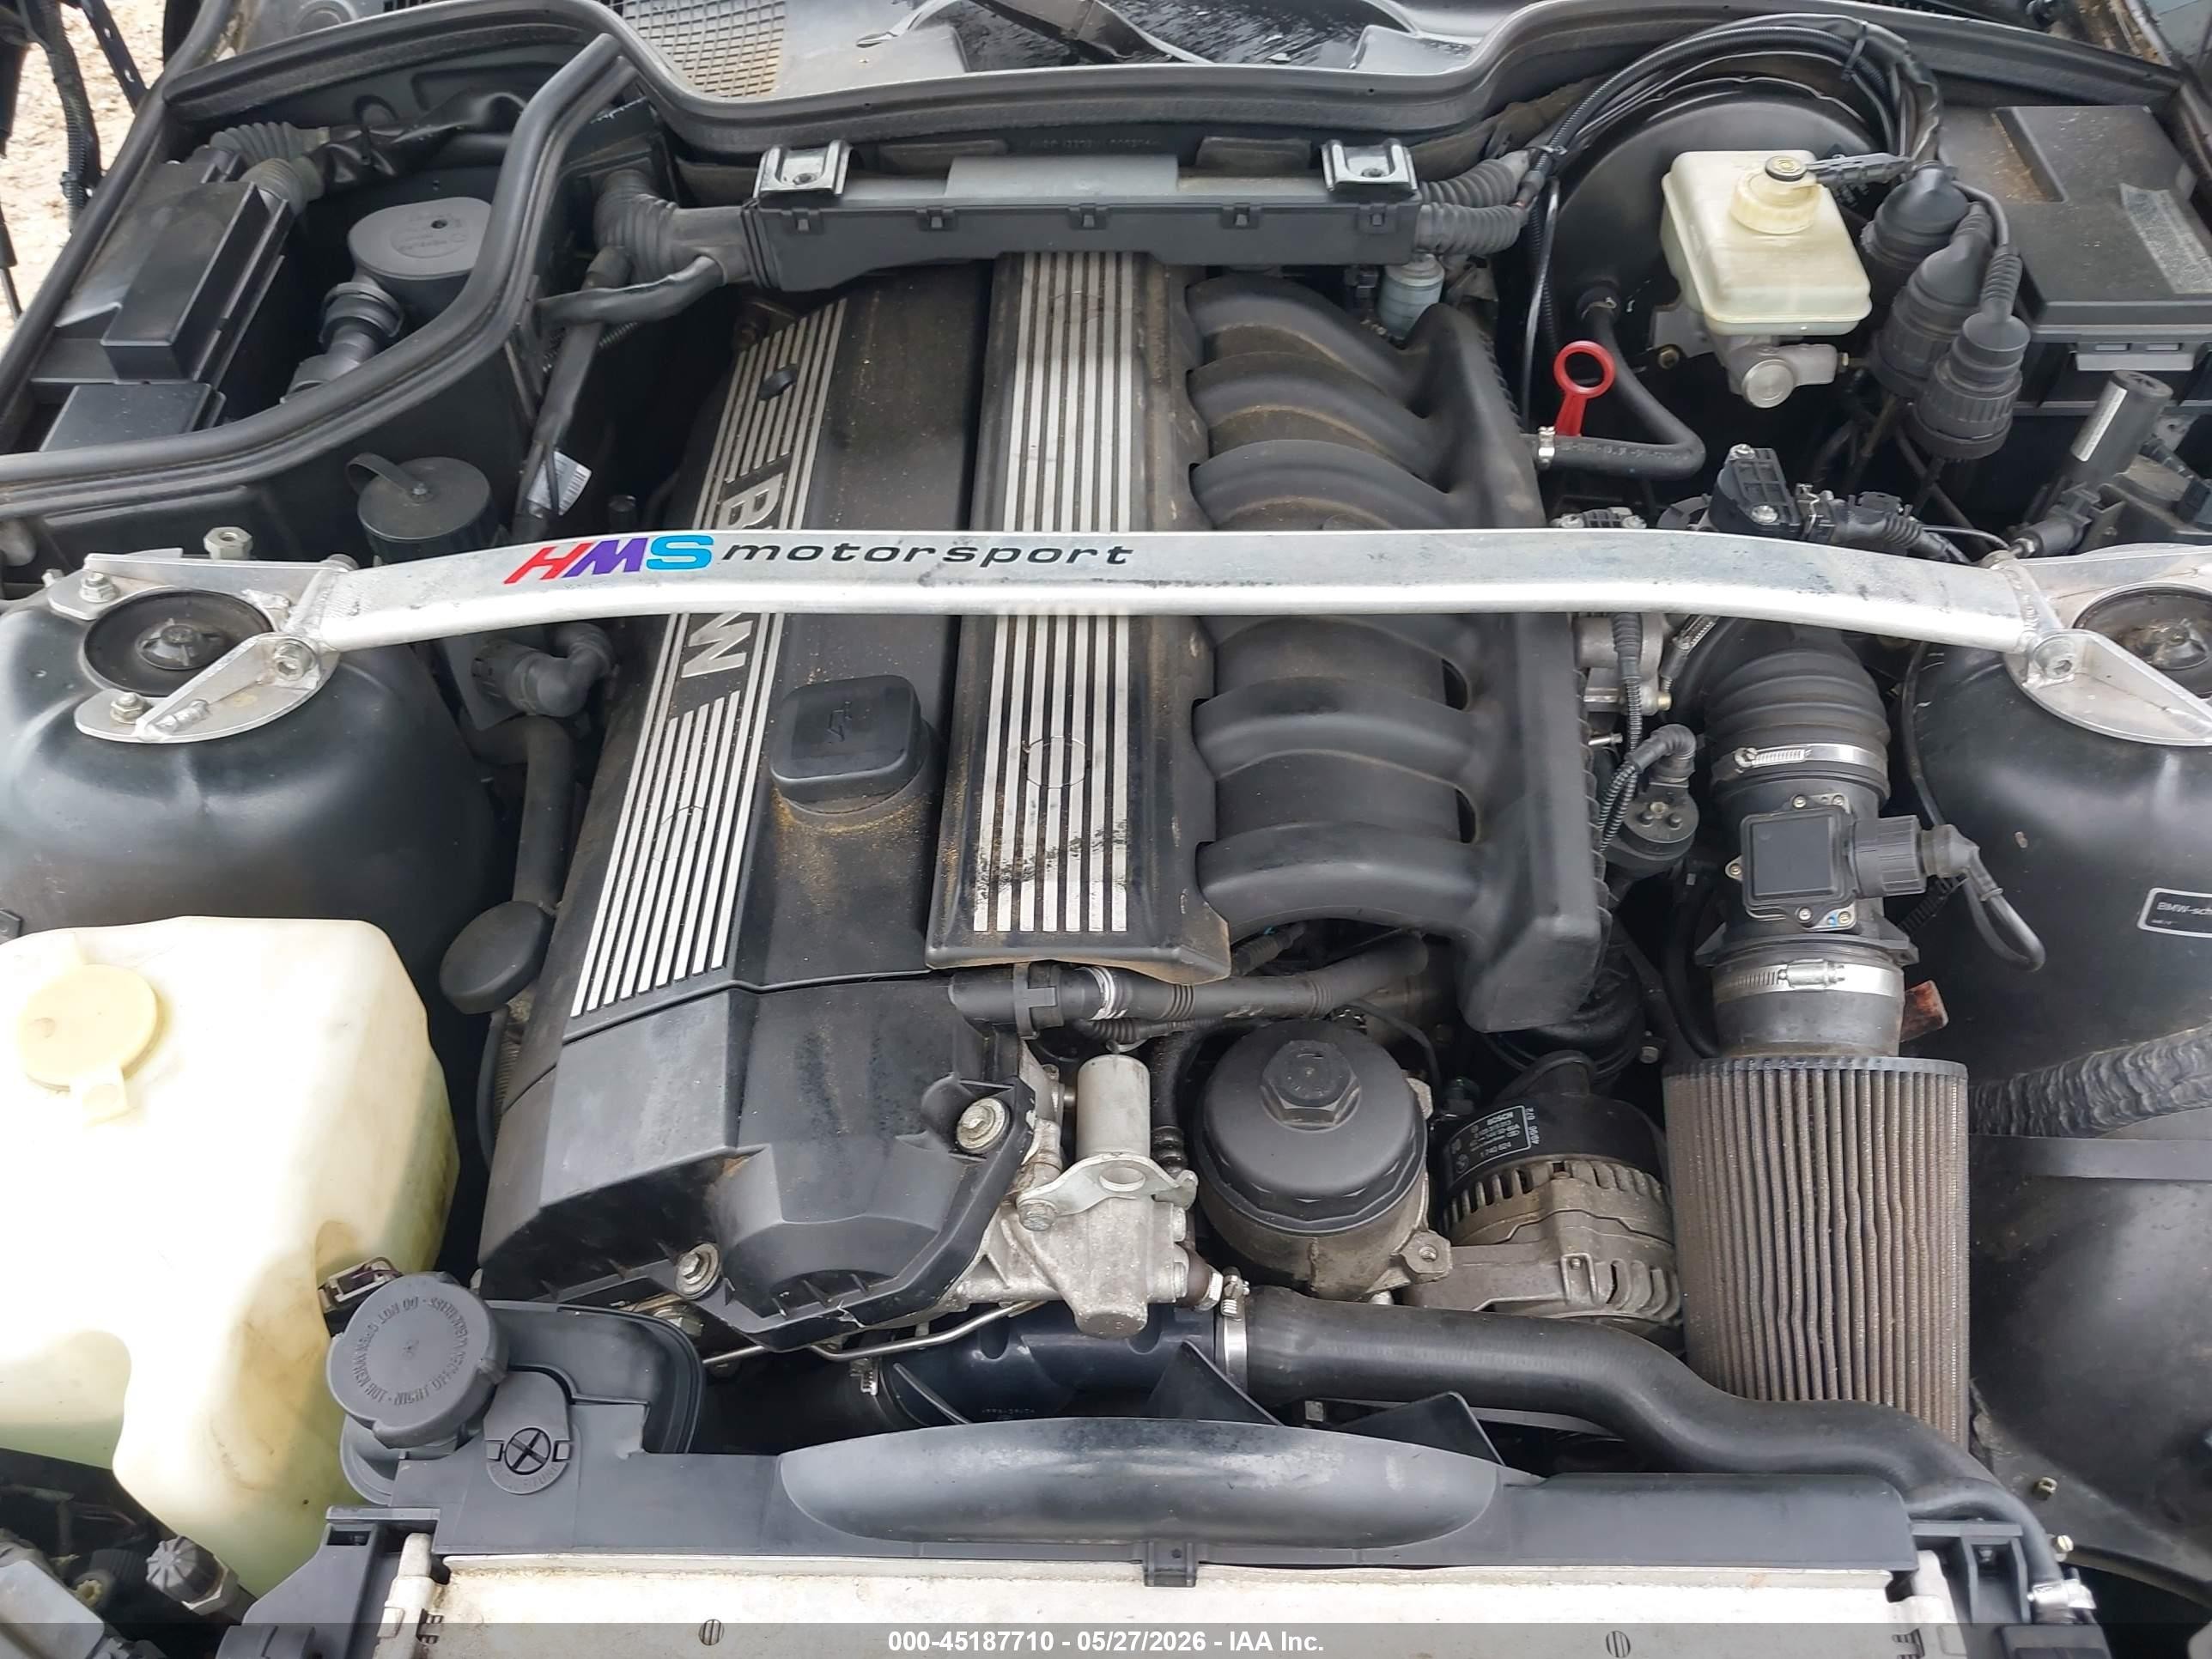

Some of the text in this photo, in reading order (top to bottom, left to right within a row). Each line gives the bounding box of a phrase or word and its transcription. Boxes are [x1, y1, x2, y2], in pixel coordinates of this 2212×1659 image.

[503, 535, 1133, 585] HMS motorsport
[681, 472, 784, 672] BW
